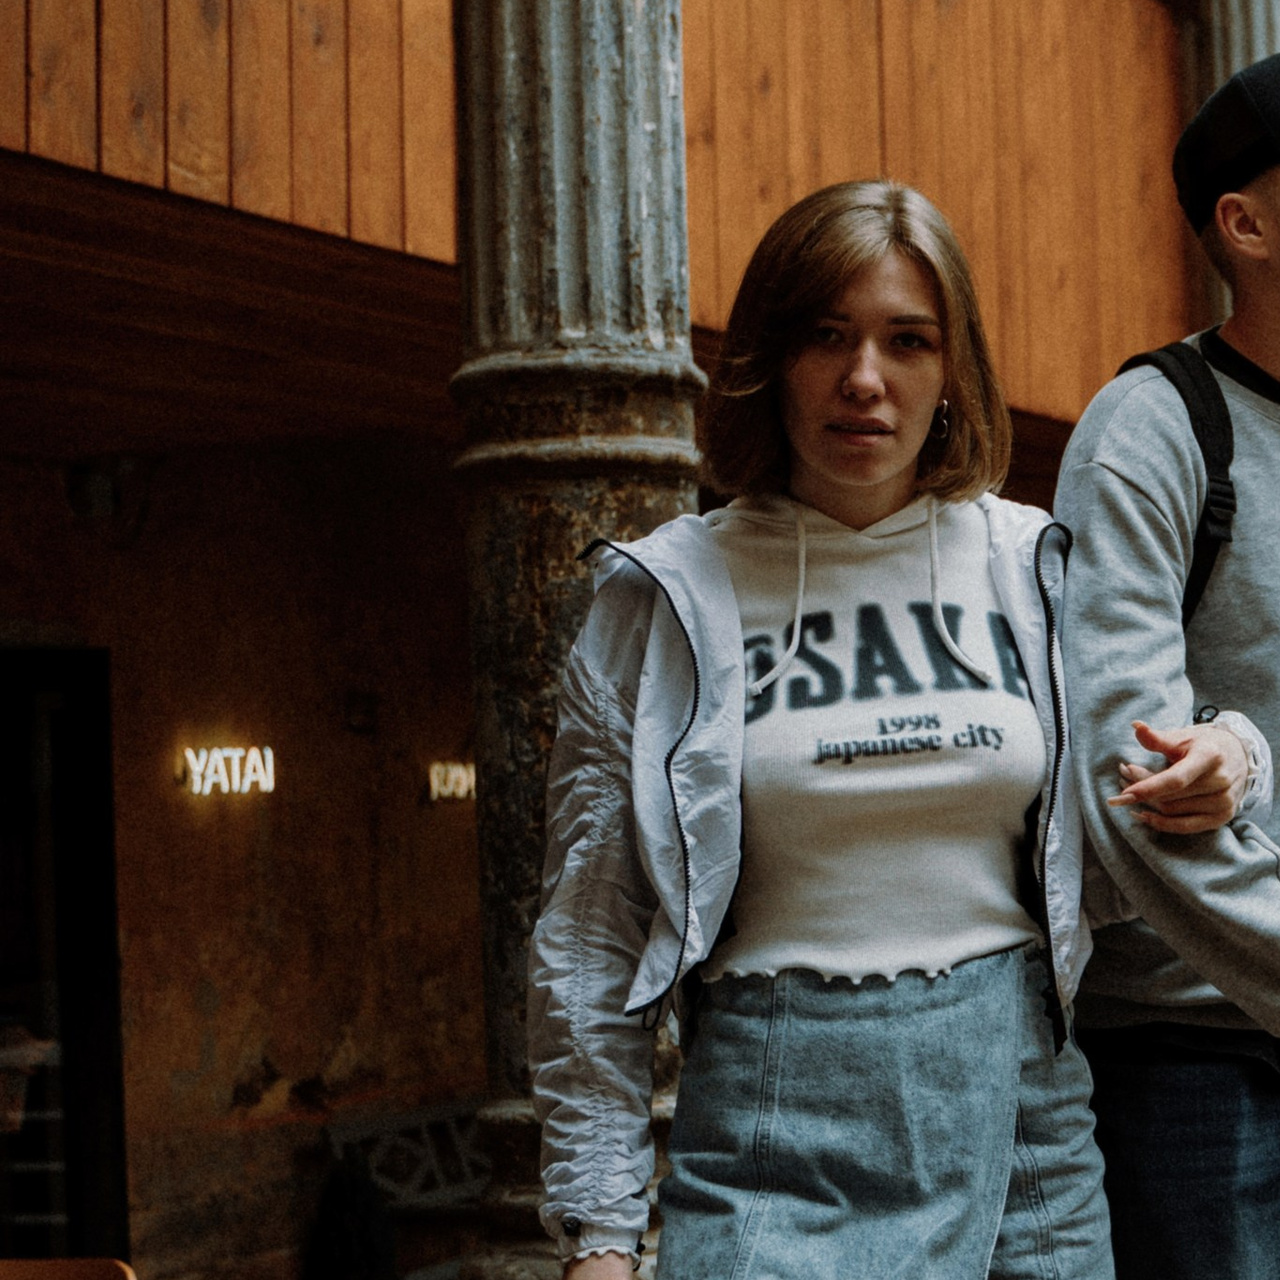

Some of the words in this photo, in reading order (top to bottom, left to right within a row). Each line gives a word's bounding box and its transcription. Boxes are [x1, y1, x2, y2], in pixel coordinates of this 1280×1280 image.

[813, 735, 942, 765] japanese
[953, 723, 1004, 751] city
[877, 714, 941, 735] 1998
[184, 746, 275, 796] YATAI
